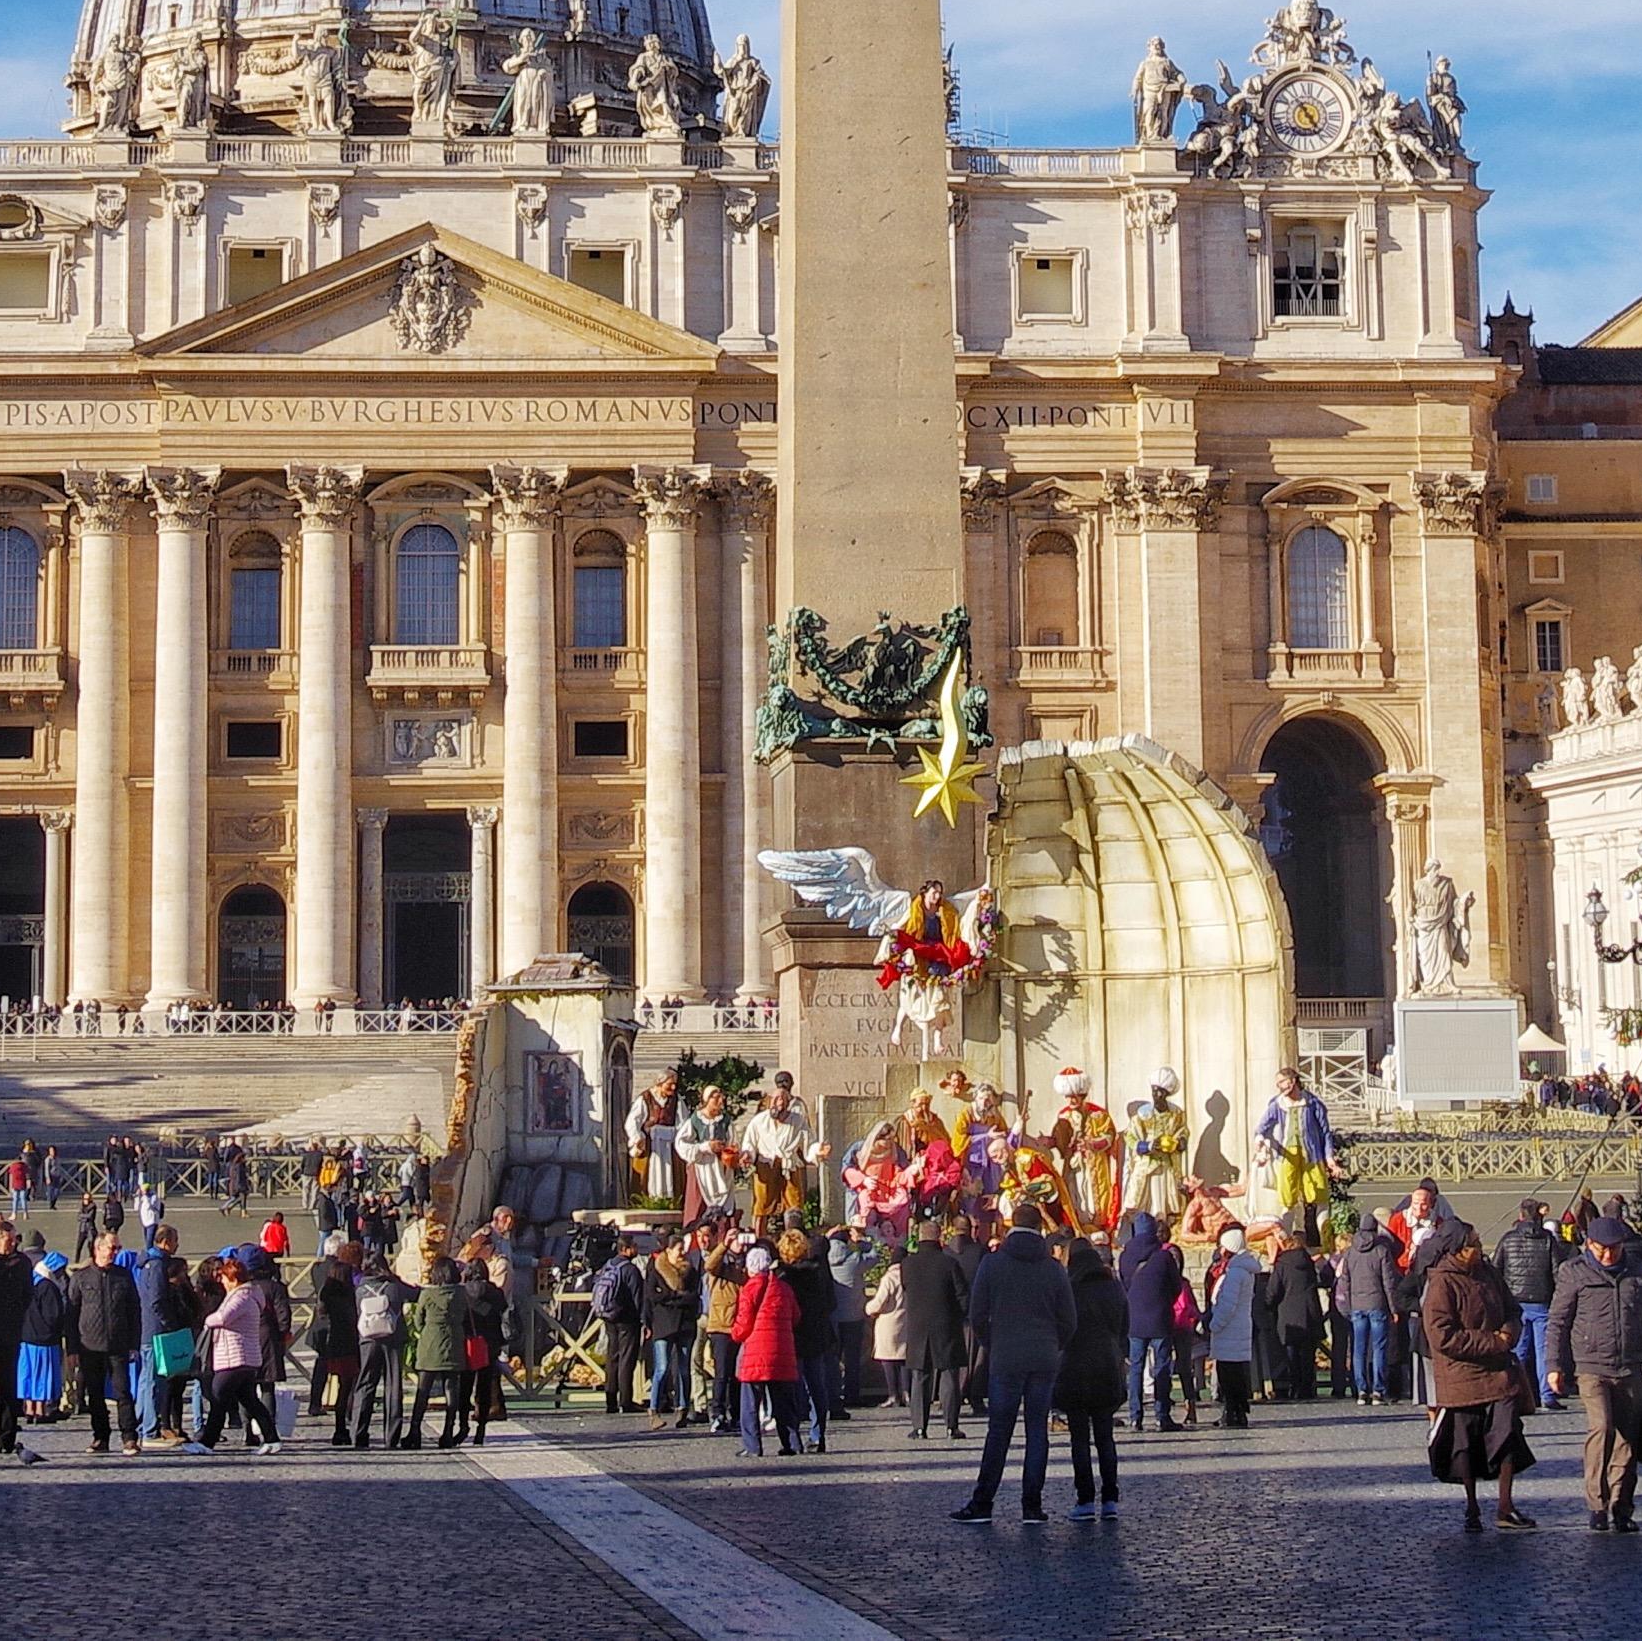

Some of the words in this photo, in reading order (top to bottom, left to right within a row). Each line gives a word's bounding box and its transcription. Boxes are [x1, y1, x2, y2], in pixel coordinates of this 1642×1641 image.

[55, 401, 157, 425] APOST
[163, 399, 274, 423] PAVLVS
[282, 399, 303, 423] V
[310, 399, 514, 423] BVRGHESIVS
[523, 399, 691, 423] ROMANVS
[700, 401, 777, 425] PONT
[956, 405, 1037, 428] CXII
[1050, 405, 1132, 428] PONT
[1146, 402, 1191, 425] VII
[809, 1043, 870, 1058] PARTES
